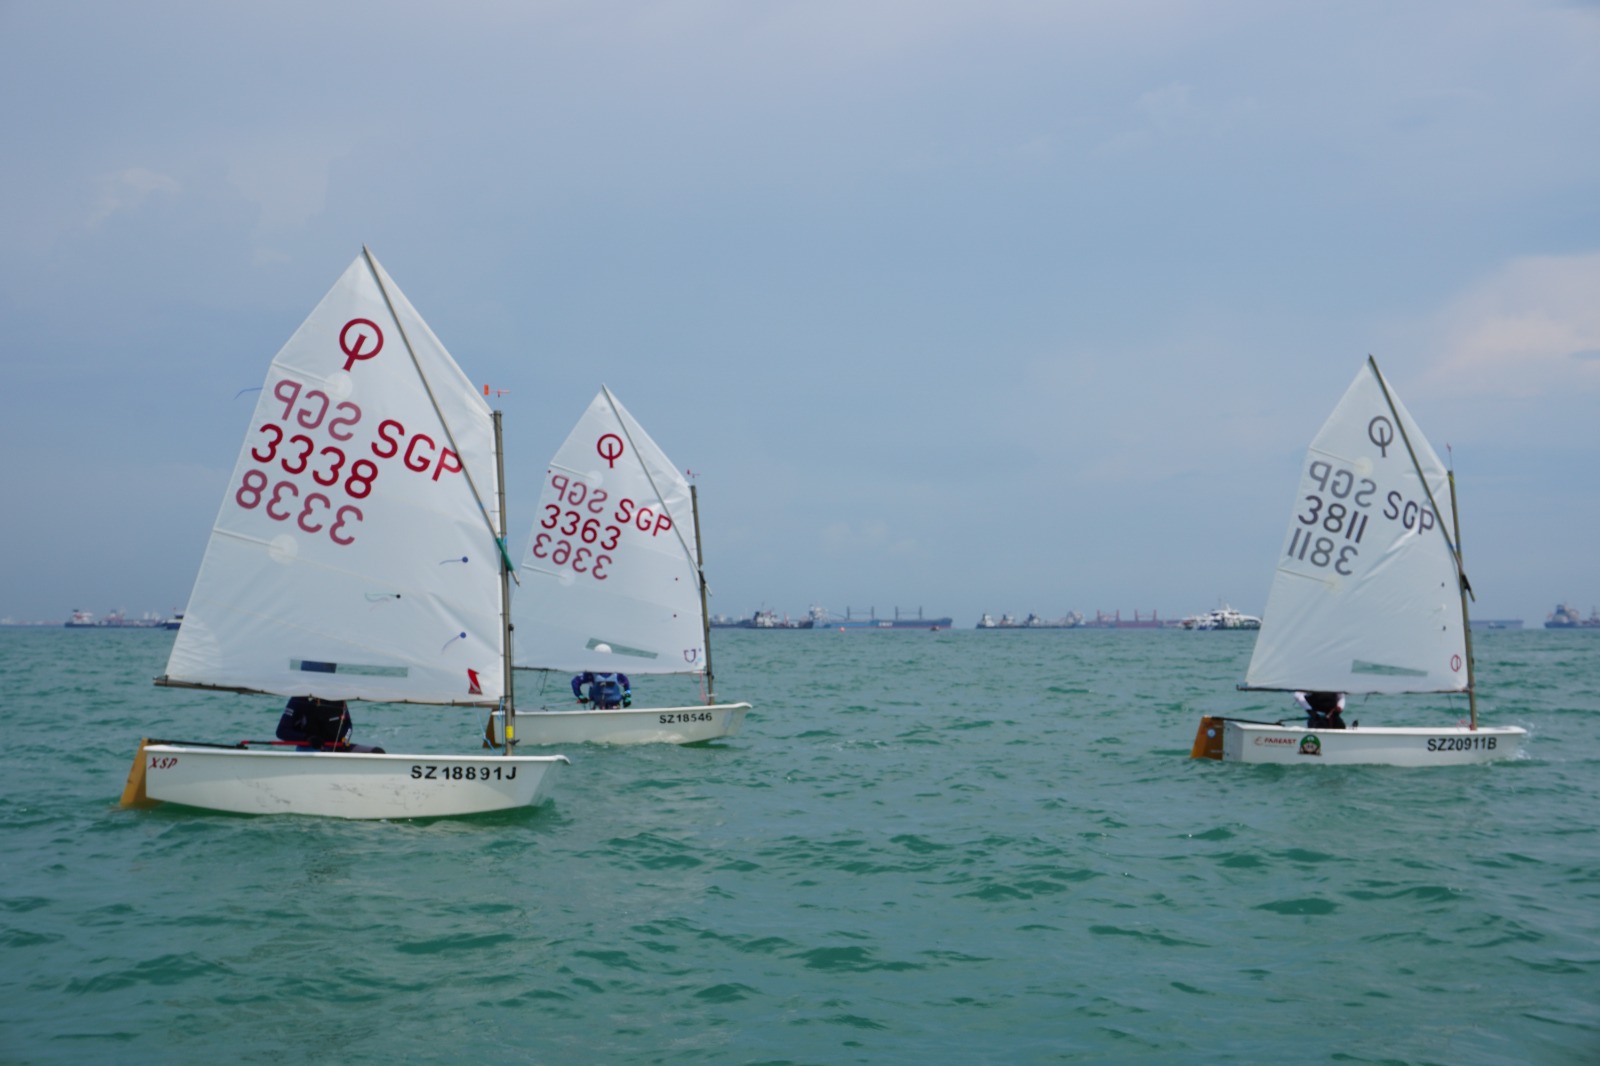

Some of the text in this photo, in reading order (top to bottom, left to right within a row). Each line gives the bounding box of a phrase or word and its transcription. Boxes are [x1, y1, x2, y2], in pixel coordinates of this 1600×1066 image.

[251, 423, 378, 499] 3338
[371, 419, 464, 482] SGP
[541, 504, 621, 551] 3363
[614, 498, 673, 537] SGP
[1298, 495, 1368, 544] 3811
[1383, 490, 1435, 535] SGP
[659, 712, 713, 724] SZ18546
[148, 757, 178, 769] XSP
[1427, 737, 1497, 752] SZ20911B
[411, 765, 517, 781] SZ18891J
